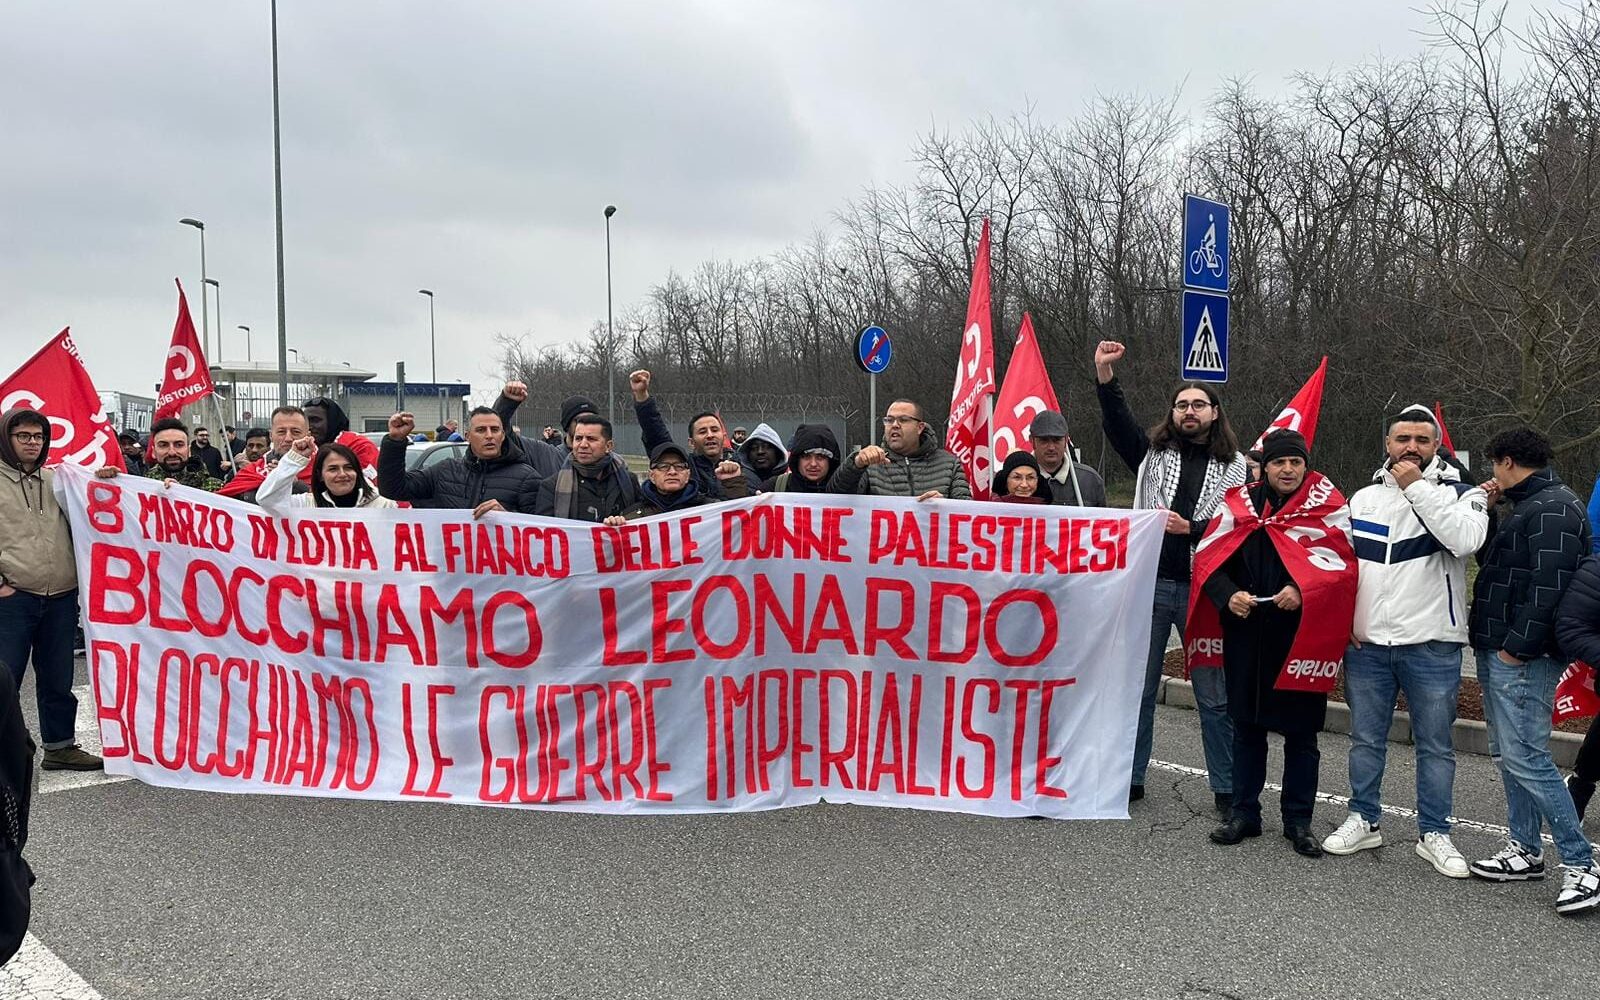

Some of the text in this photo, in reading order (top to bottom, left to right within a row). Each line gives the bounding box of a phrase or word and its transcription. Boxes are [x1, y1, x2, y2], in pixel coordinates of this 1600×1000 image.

[87, 482, 125, 535] 8
[138, 492, 234, 554] MARZO
[248, 515, 279, 561] DI
[282, 519, 379, 571] LOTTA
[395, 522, 438, 573] AL
[442, 523, 571, 580] FIANCO
[592, 515, 704, 574] DELLE
[722, 504, 854, 563] DONNE
[869, 510, 1130, 575] PALESTINESI
[89, 541, 1059, 669] BLOCCHIAMO LEONARDO
[92, 640, 1076, 805] BLOCCHIAMO LE GUERRE IMPERIALISTE
